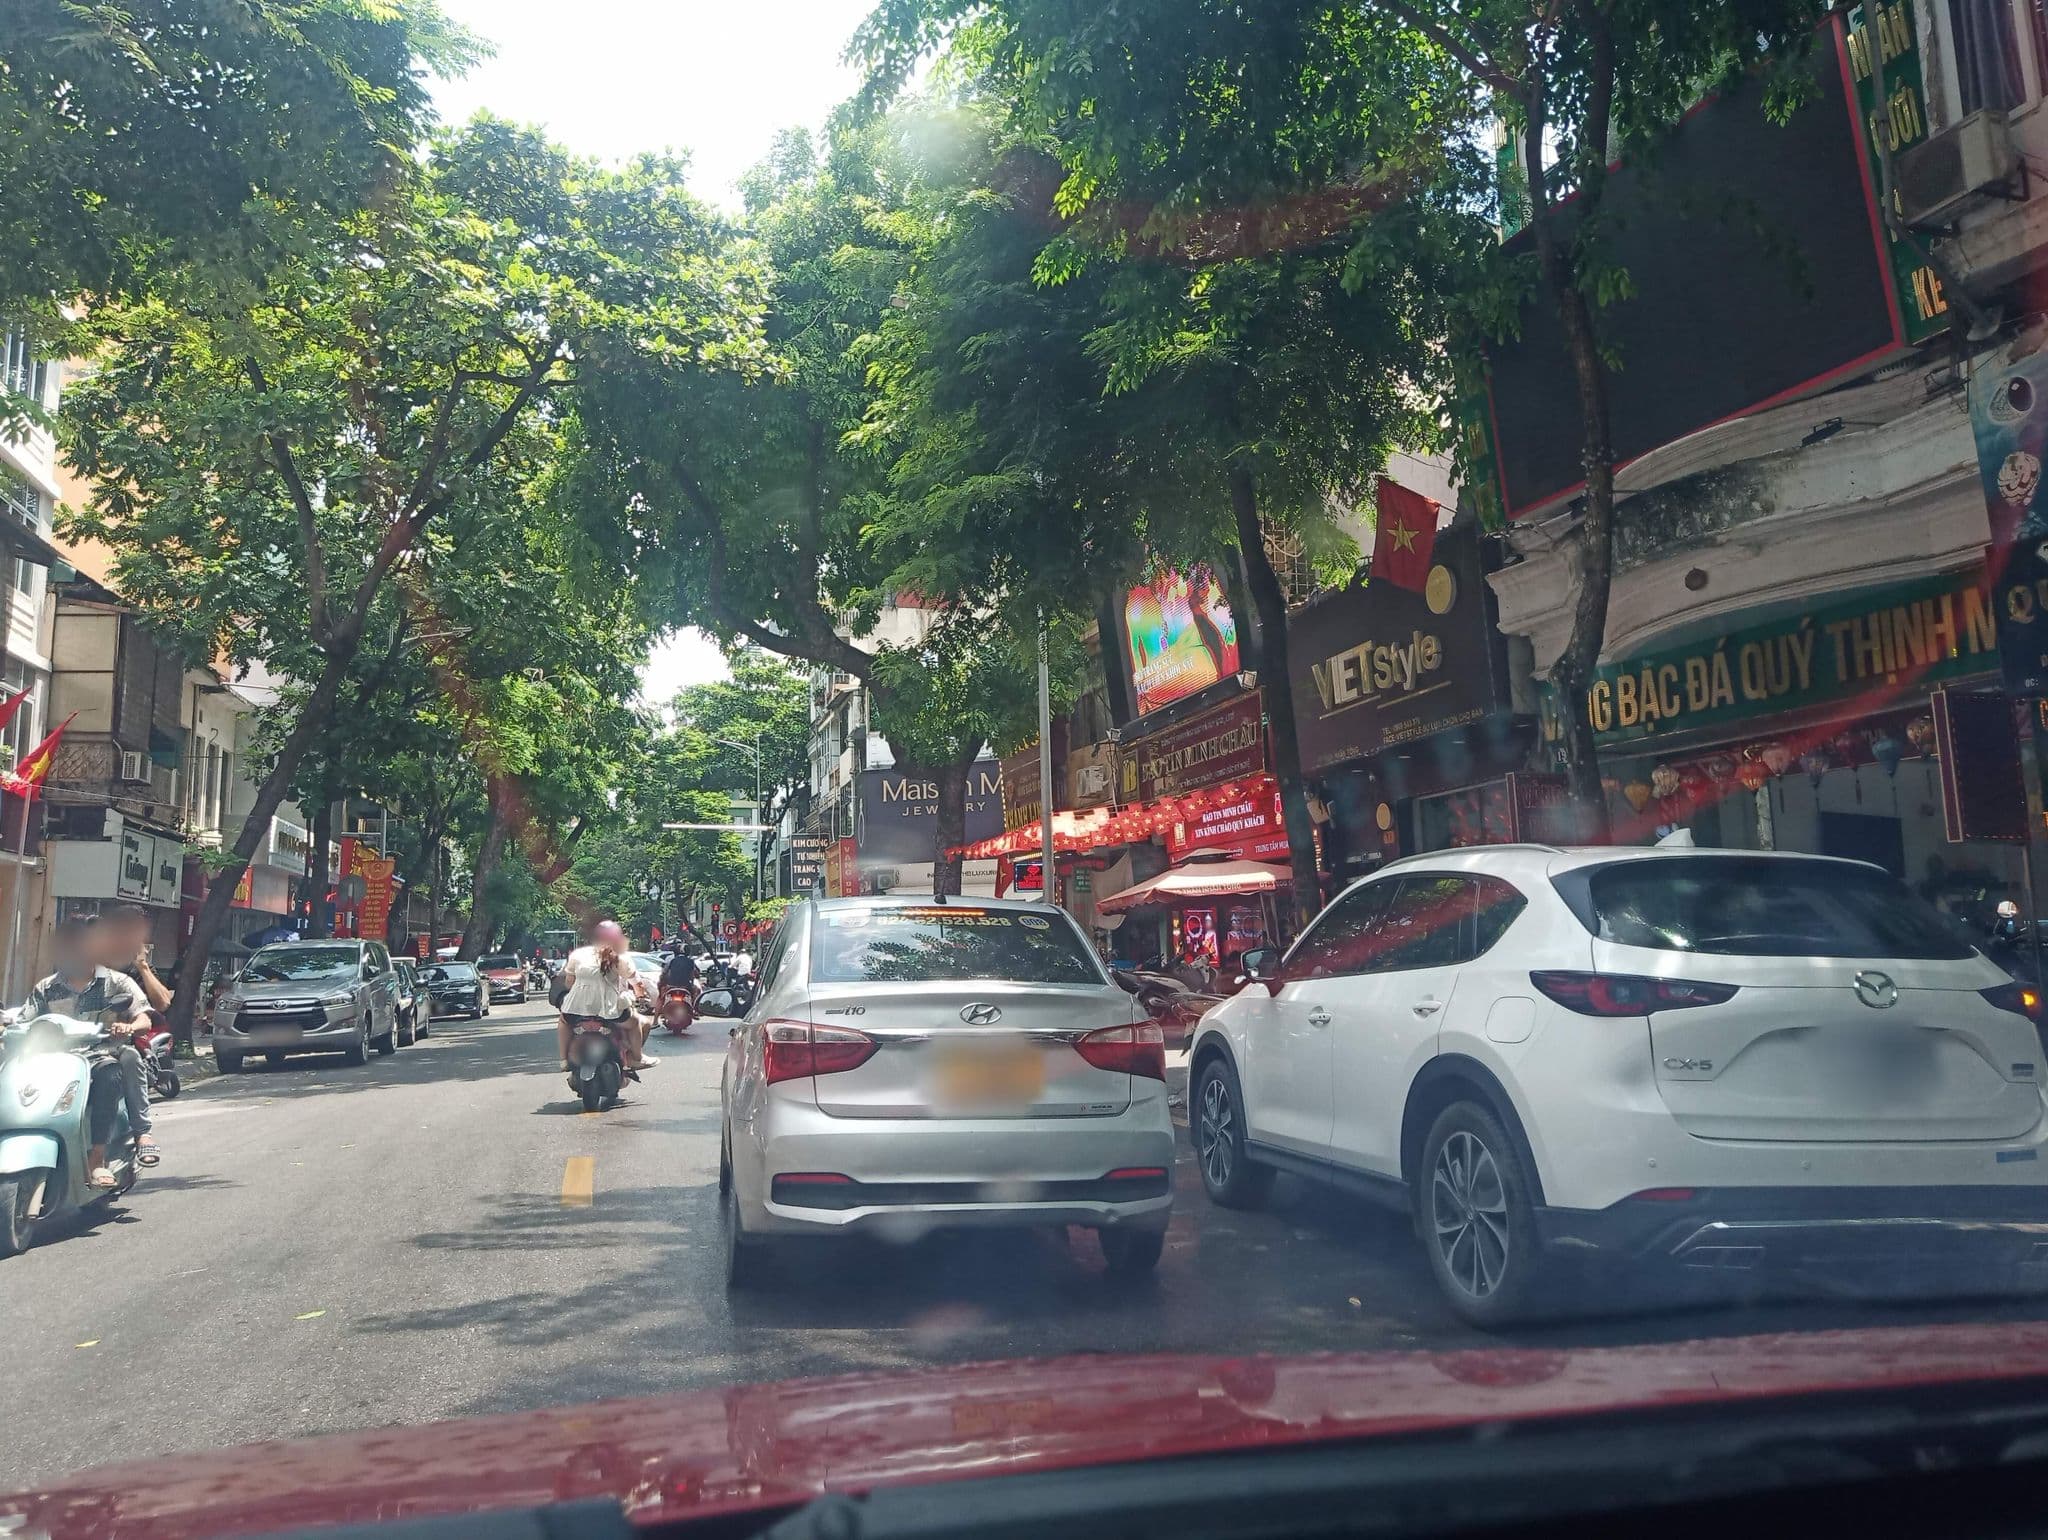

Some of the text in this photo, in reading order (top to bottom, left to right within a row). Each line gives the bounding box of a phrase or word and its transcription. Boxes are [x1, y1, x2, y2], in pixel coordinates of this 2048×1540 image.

[1685, 635, 1736, 712] ĐÁ
[1740, 615, 1815, 700] QUÝ
[1826, 592, 1959, 685] THỊNH
[902, 801, 986, 816] JEWRY
[793, 864, 816, 874] TRANG
[797, 877, 812, 887] CAO
[1663, 1057, 1713, 1071] CX-5
